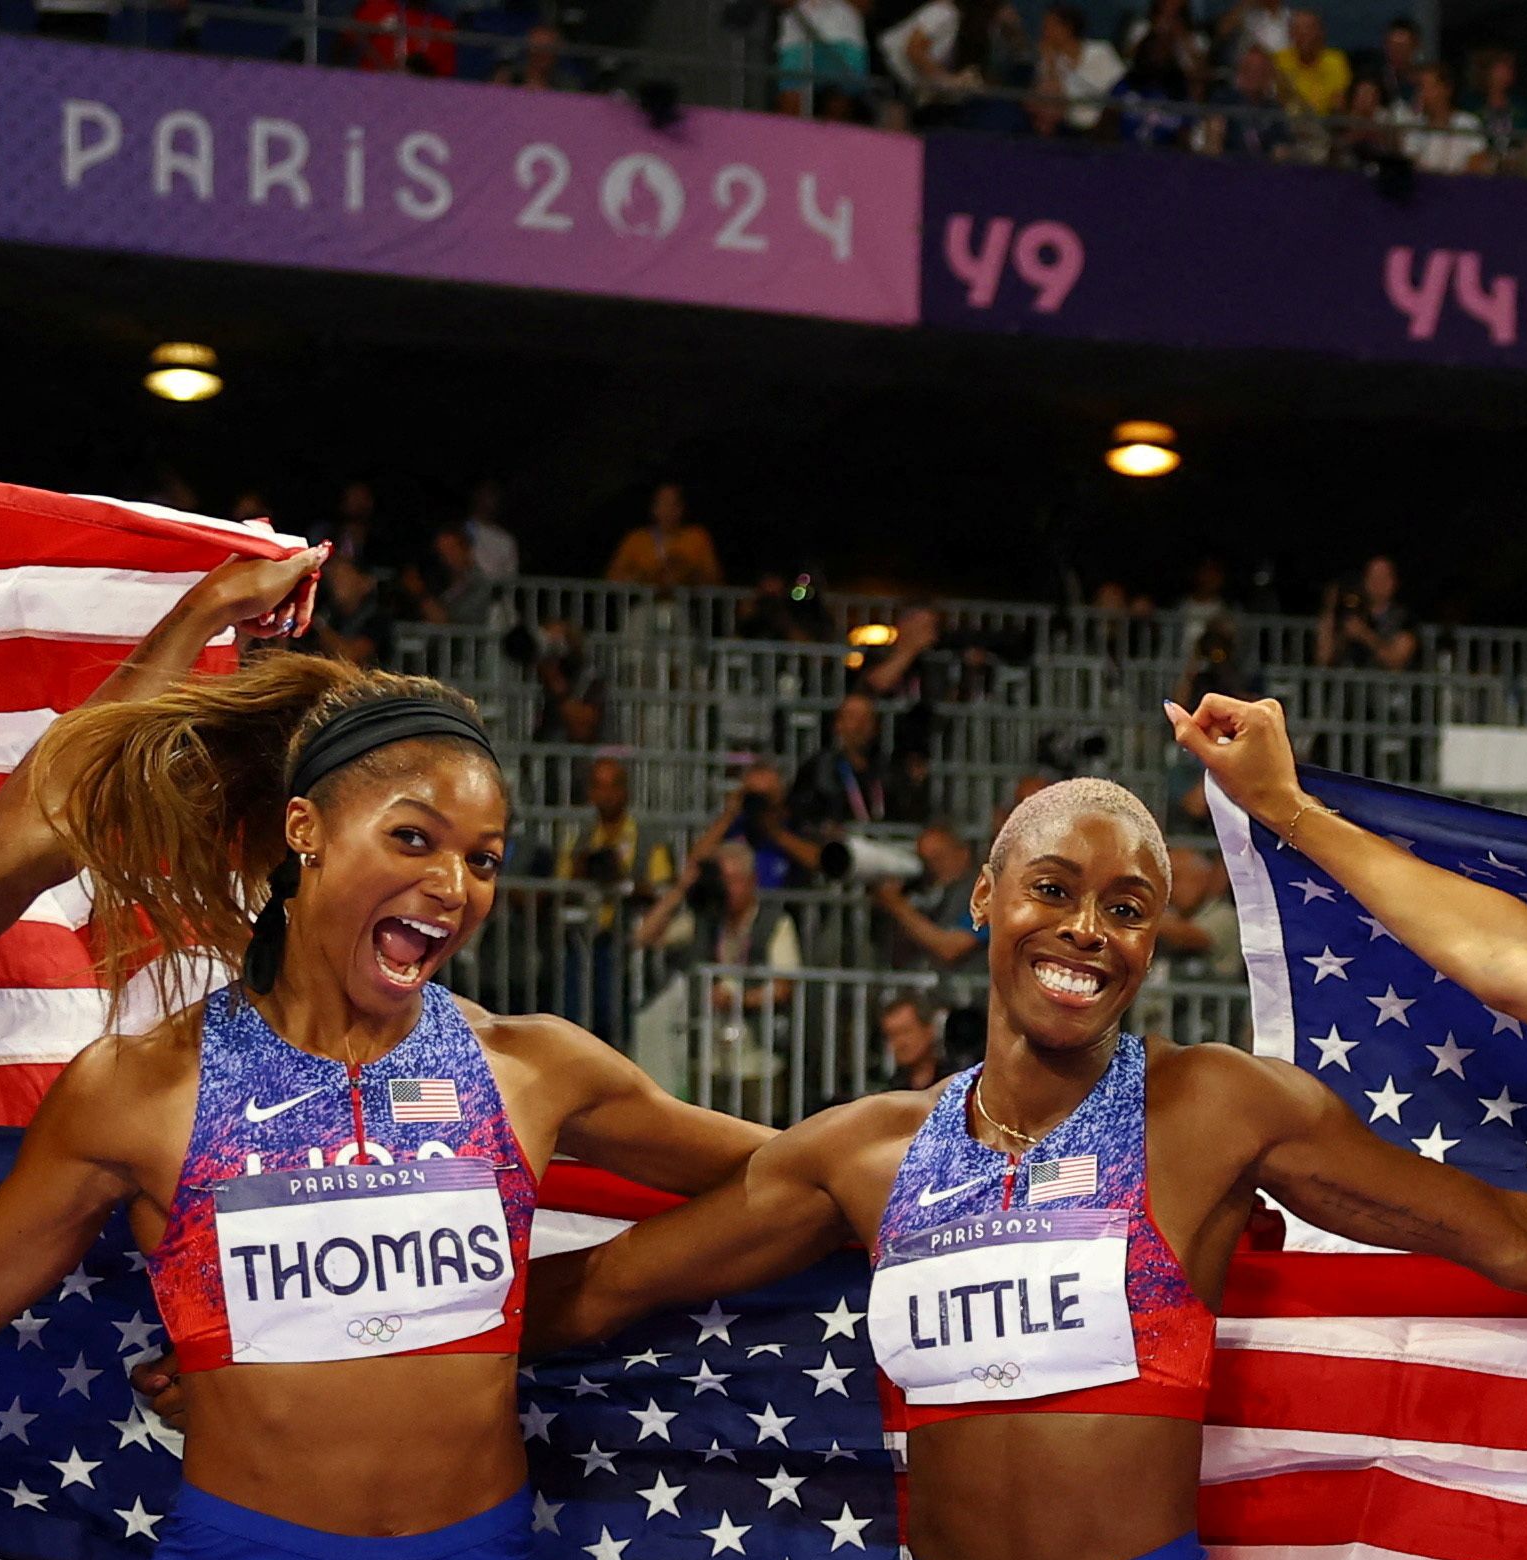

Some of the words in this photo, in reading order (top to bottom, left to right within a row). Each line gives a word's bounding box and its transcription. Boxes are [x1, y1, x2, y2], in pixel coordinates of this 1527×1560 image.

[514, 141, 854, 260] 2024
[365, 1168, 426, 1189] 2024
[229, 1225, 505, 1302] THOMAS
[991, 1218, 1052, 1236] 2024
[908, 1272, 1086, 1350] LITTLE
